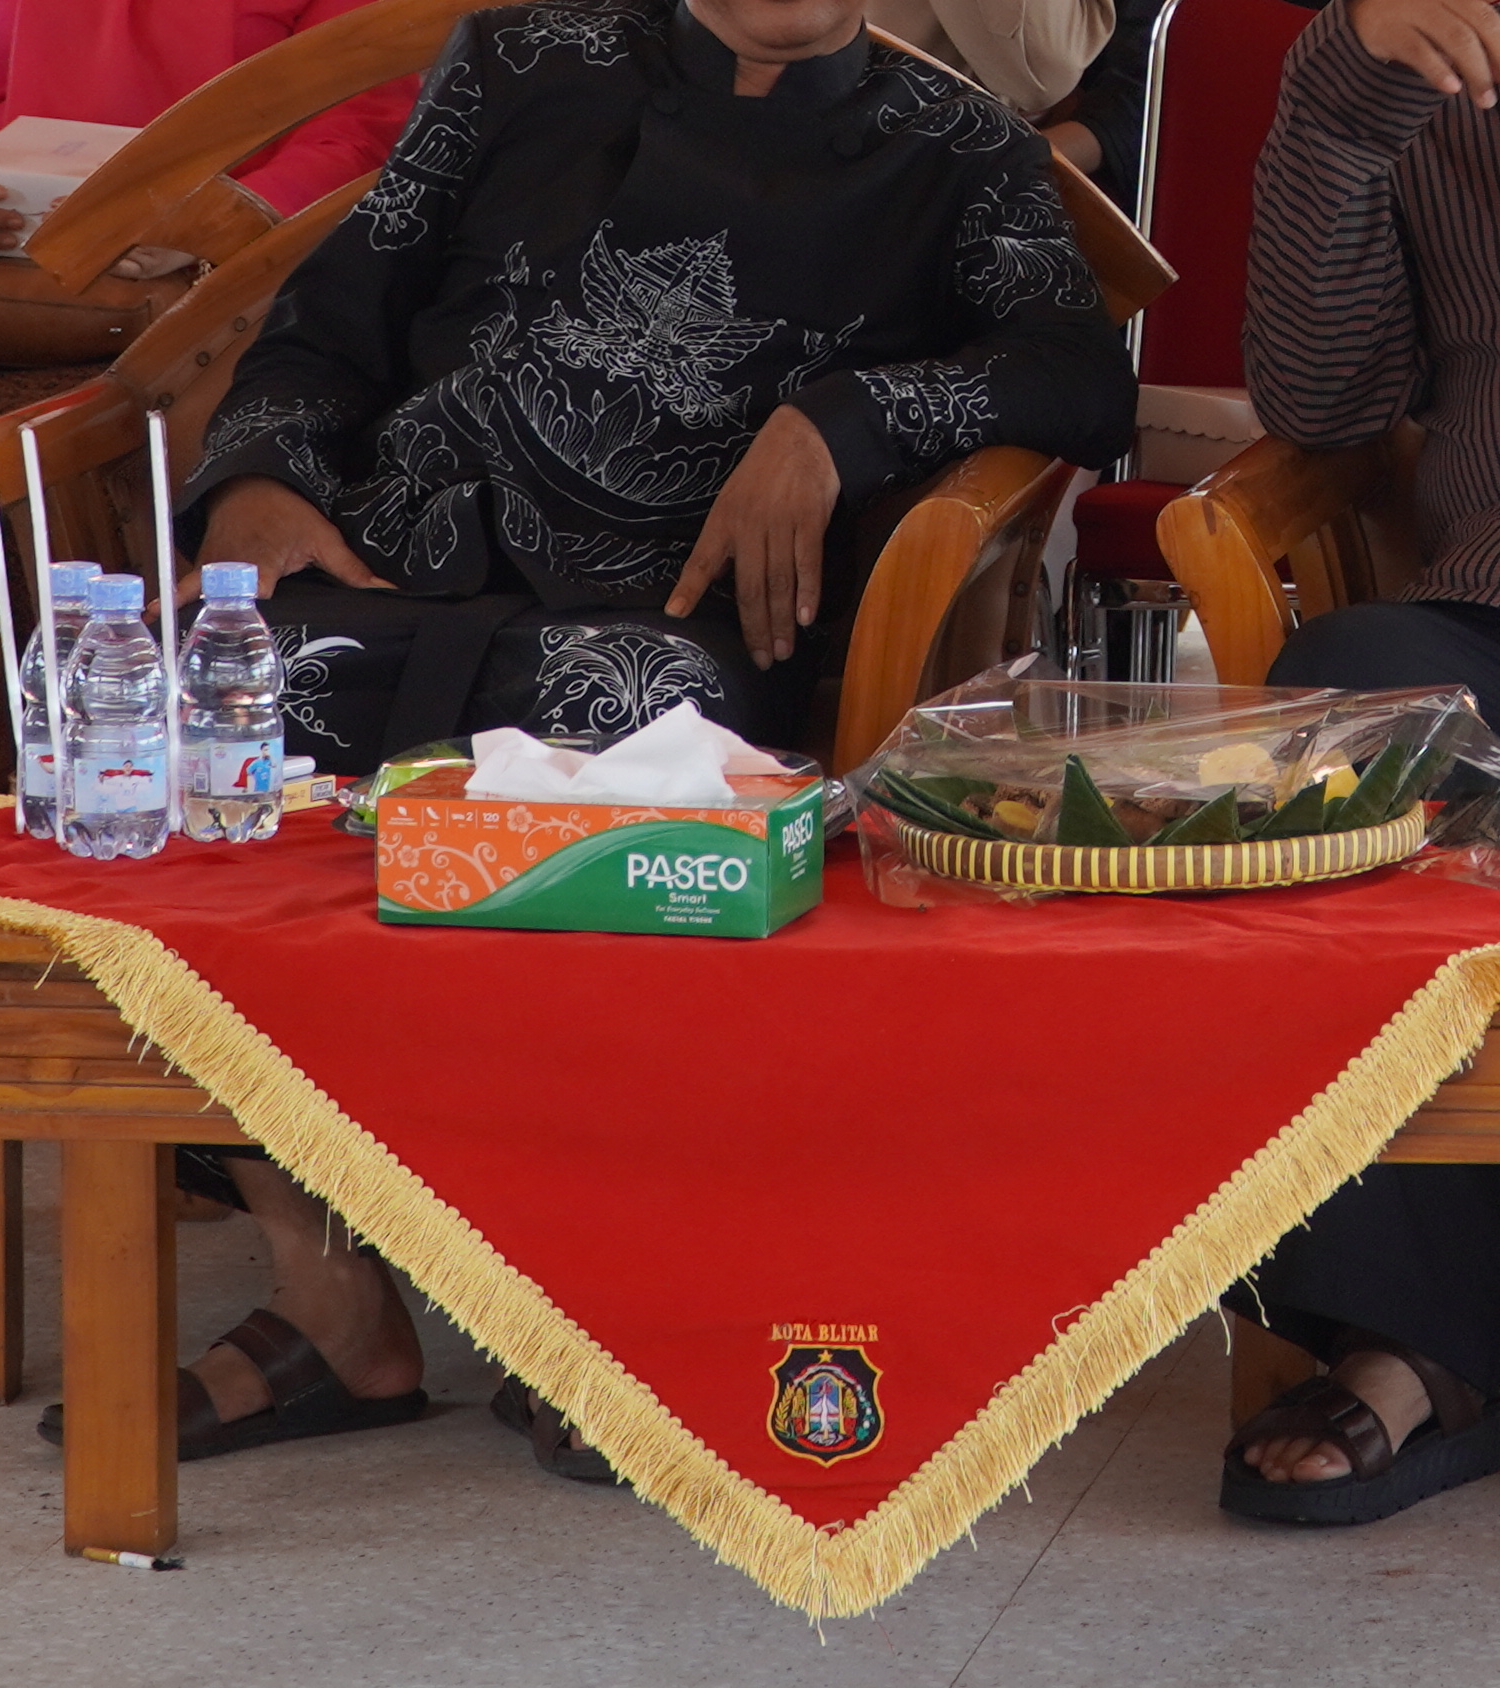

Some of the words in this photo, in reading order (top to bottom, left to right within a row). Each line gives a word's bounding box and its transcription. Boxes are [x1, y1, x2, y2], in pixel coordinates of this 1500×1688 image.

[782, 809, 815, 858] PASEO
[627, 853, 748, 892] PASEO
[668, 892, 708, 905] Smart
[770, 1323, 813, 1342] KOTA
[818, 1323, 880, 1343] BLITAR
